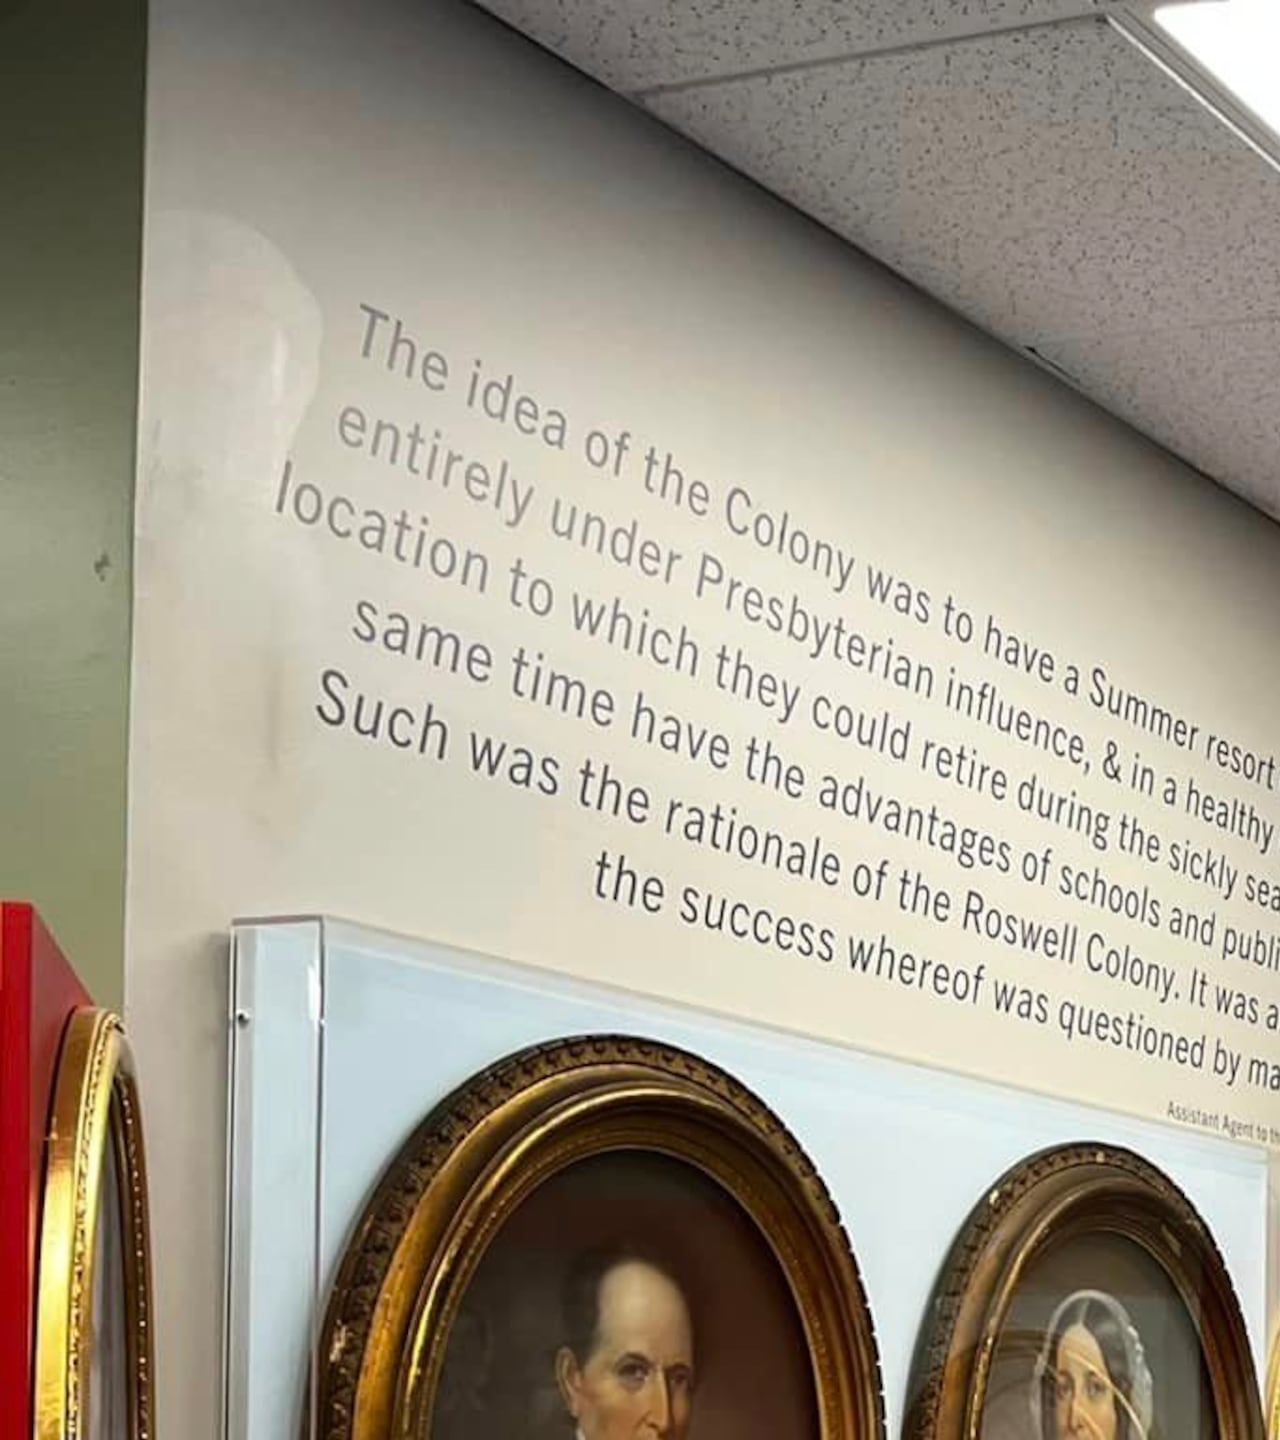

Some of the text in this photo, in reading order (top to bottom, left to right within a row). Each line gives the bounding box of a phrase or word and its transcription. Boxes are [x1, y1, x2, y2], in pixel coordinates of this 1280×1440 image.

[275, 460, 489, 594] location
[509, 558, 554, 618] to
[572, 592, 699, 678] which
[715, 644, 802, 725] they
[812, 694, 912, 763] could
[920, 739, 1008, 802] retire
[1017, 774, 1111, 852] during
[1118, 812, 1161, 864] the
[1166, 839, 1239, 901] sickly
[338, 406, 535, 529] entirely
[551, 497, 683, 585] under
[695, 553, 934, 700] Presbyterian
[945, 666, 1091, 777] influence,
[1101, 739, 1123, 785] &
[1130, 751, 1155, 798] in
[1162, 776, 1178, 807] a
[1184, 777, 1275, 856] healthy
[359, 303, 449, 392] The
[466, 359, 567, 451] idea
[585, 430, 632, 478] of
[644, 445, 710, 517] the
[725, 486, 856, 594] Colony
[867, 564, 931, 625] was
[943, 594, 974, 644] to
[983, 614, 1055, 684] have
[1063, 664, 1080, 697] a
[1088, 667, 1200, 752] Summer
[1205, 734, 1276, 791] resort
[315, 669, 449, 761] Such
[469, 730, 561, 796] was
[578, 760, 650, 825] the
[664, 797, 841, 887] rationale
[852, 862, 888, 902] of
[898, 869, 951, 924] the
[961, 892, 1079, 965] Roswell
[1085, 934, 1180, 1005] Colony.
[1189, 970, 1209, 1009] It
[1214, 984, 1259, 1025] was
[351, 599, 493, 684] same
[511, 648, 615, 728] time
[631, 693, 731, 771] have
[745, 737, 806, 800] the
[818, 774, 1012, 874] advantages
[1021, 849, 1053, 887] of
[1058, 864, 1161, 929] schools
[1168, 906, 1217, 949] and
[595, 850, 665, 914] the
[679, 886, 836, 963] success
[848, 935, 986, 1006] whereof
[993, 978, 1049, 1025] was
[1058, 1000, 1207, 1070] questioned
[1212, 1040, 1242, 1087] by
[1167, 1101, 1220, 1130] Assistant
[1222, 1119, 1252, 1142] Agent
[1256, 1125, 1267, 1142] to
